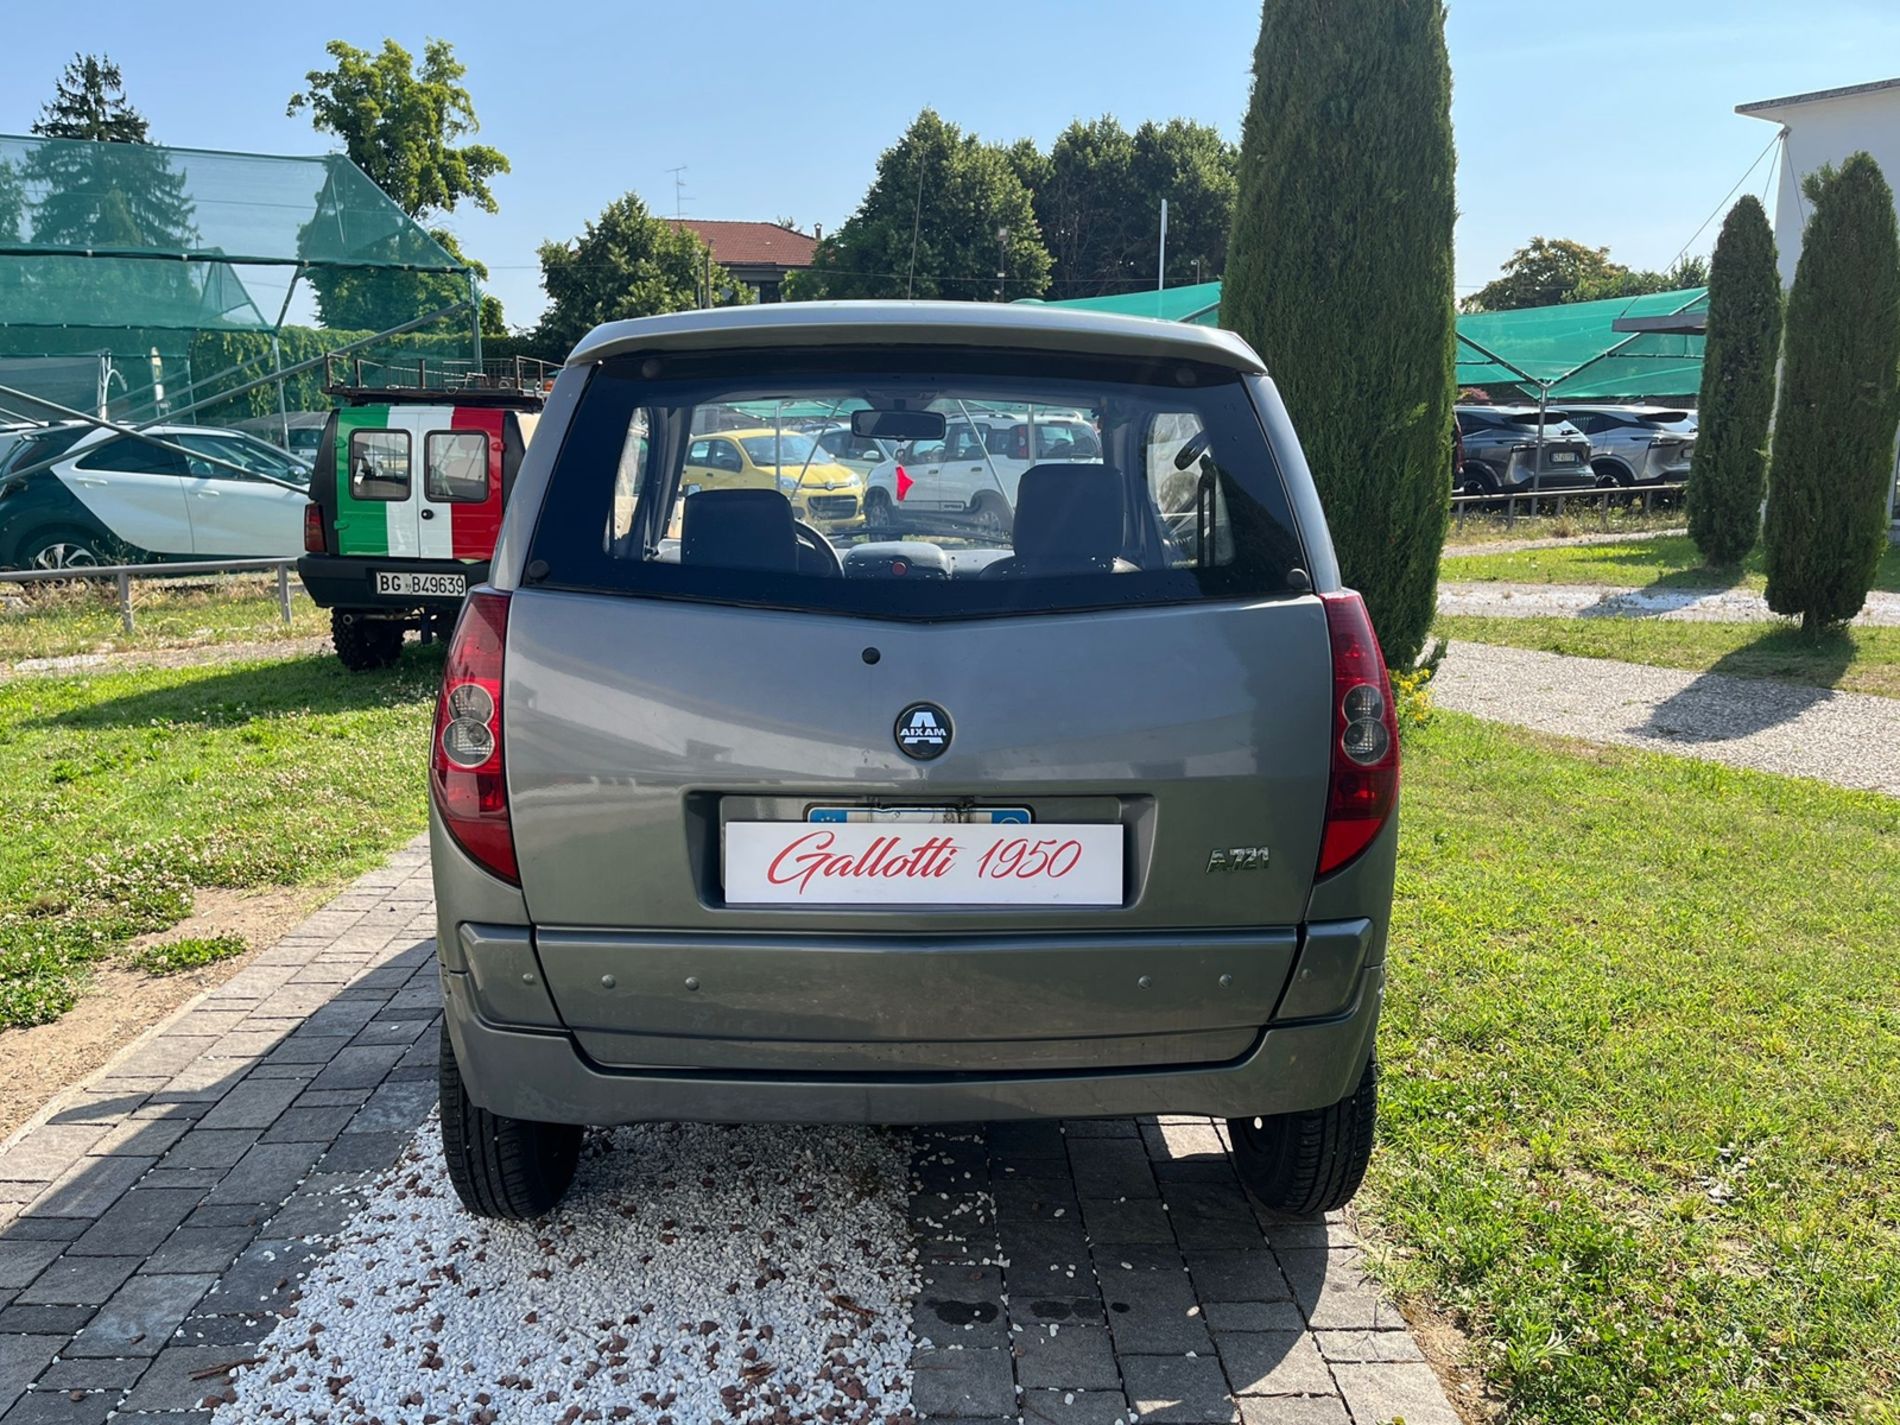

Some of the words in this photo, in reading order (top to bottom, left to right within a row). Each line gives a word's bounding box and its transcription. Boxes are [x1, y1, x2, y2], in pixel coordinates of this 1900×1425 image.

[380, 575, 401, 592] BG
[412, 576, 464, 594] B49639
[900, 728, 947, 736] AIXAM
[767, 831, 967, 894] Gallotti
[977, 838, 1082, 879] 1950
